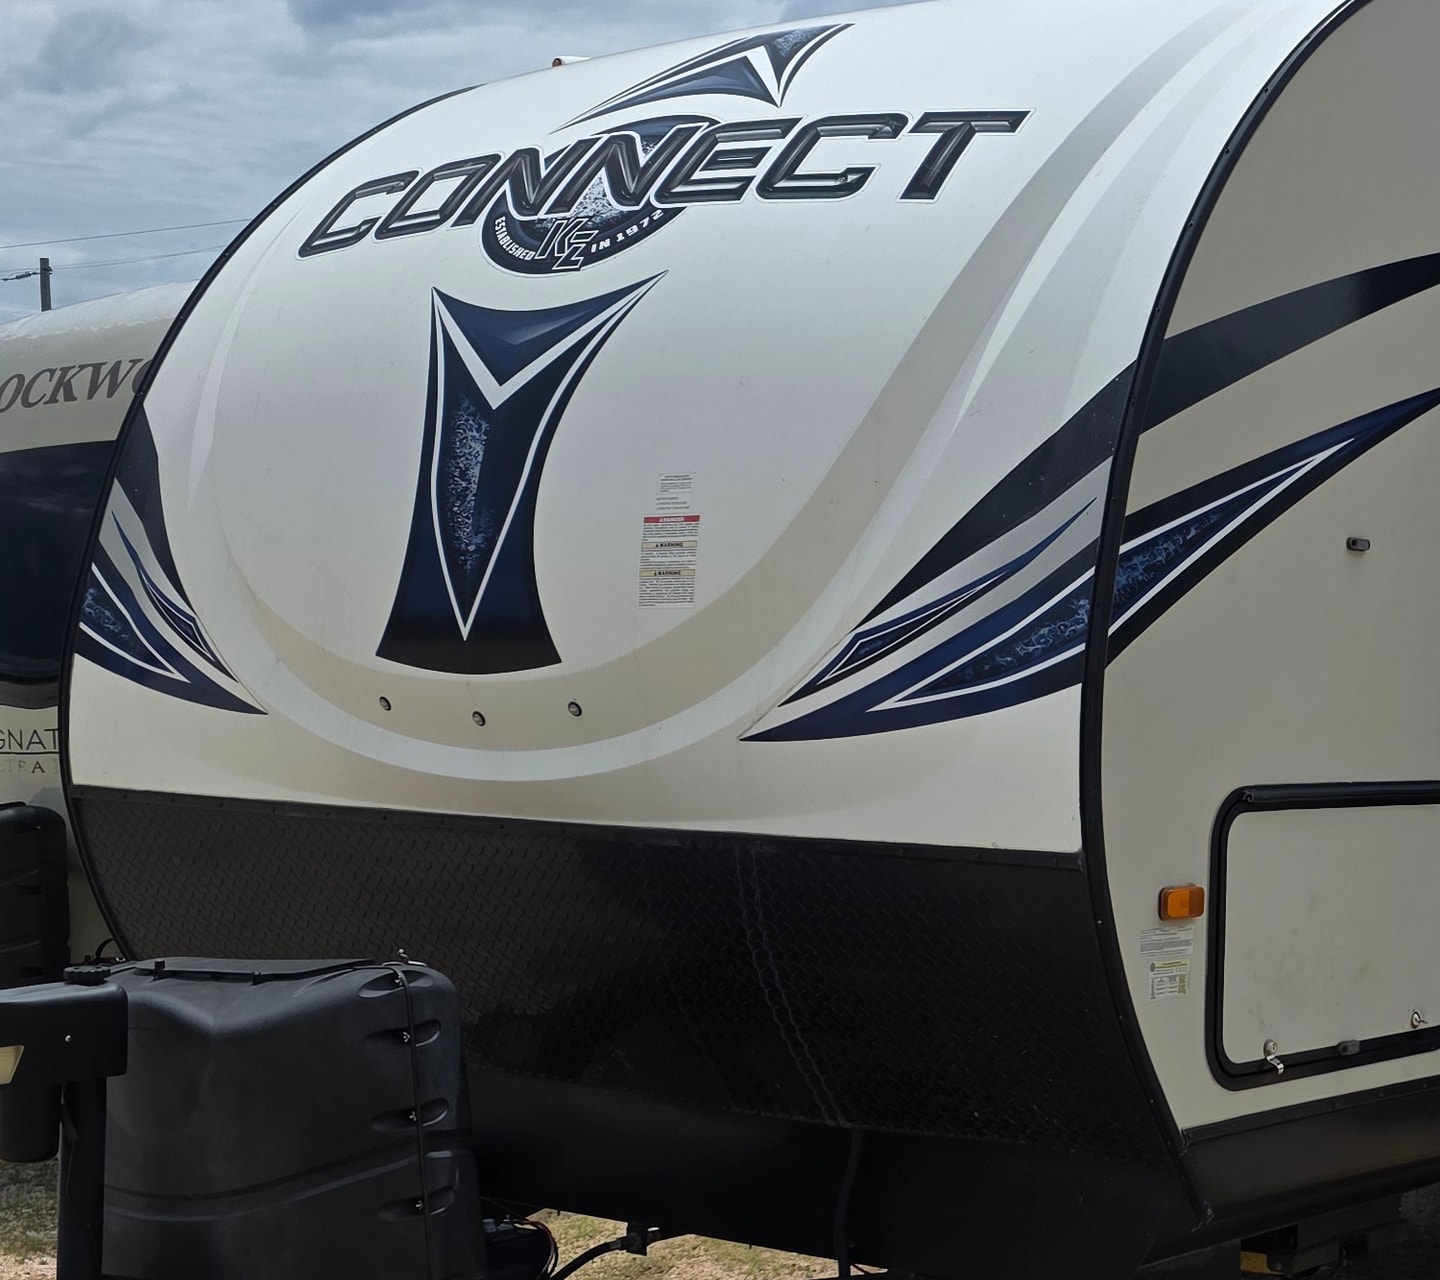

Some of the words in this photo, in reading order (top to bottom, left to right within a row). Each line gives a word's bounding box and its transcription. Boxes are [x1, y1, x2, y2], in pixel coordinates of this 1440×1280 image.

[298, 109, 1035, 259] CONNECT
[494, 216, 537, 261] ESTABLISHED
[590, 238, 611, 253] IN
[616, 209, 665, 242] 1972
